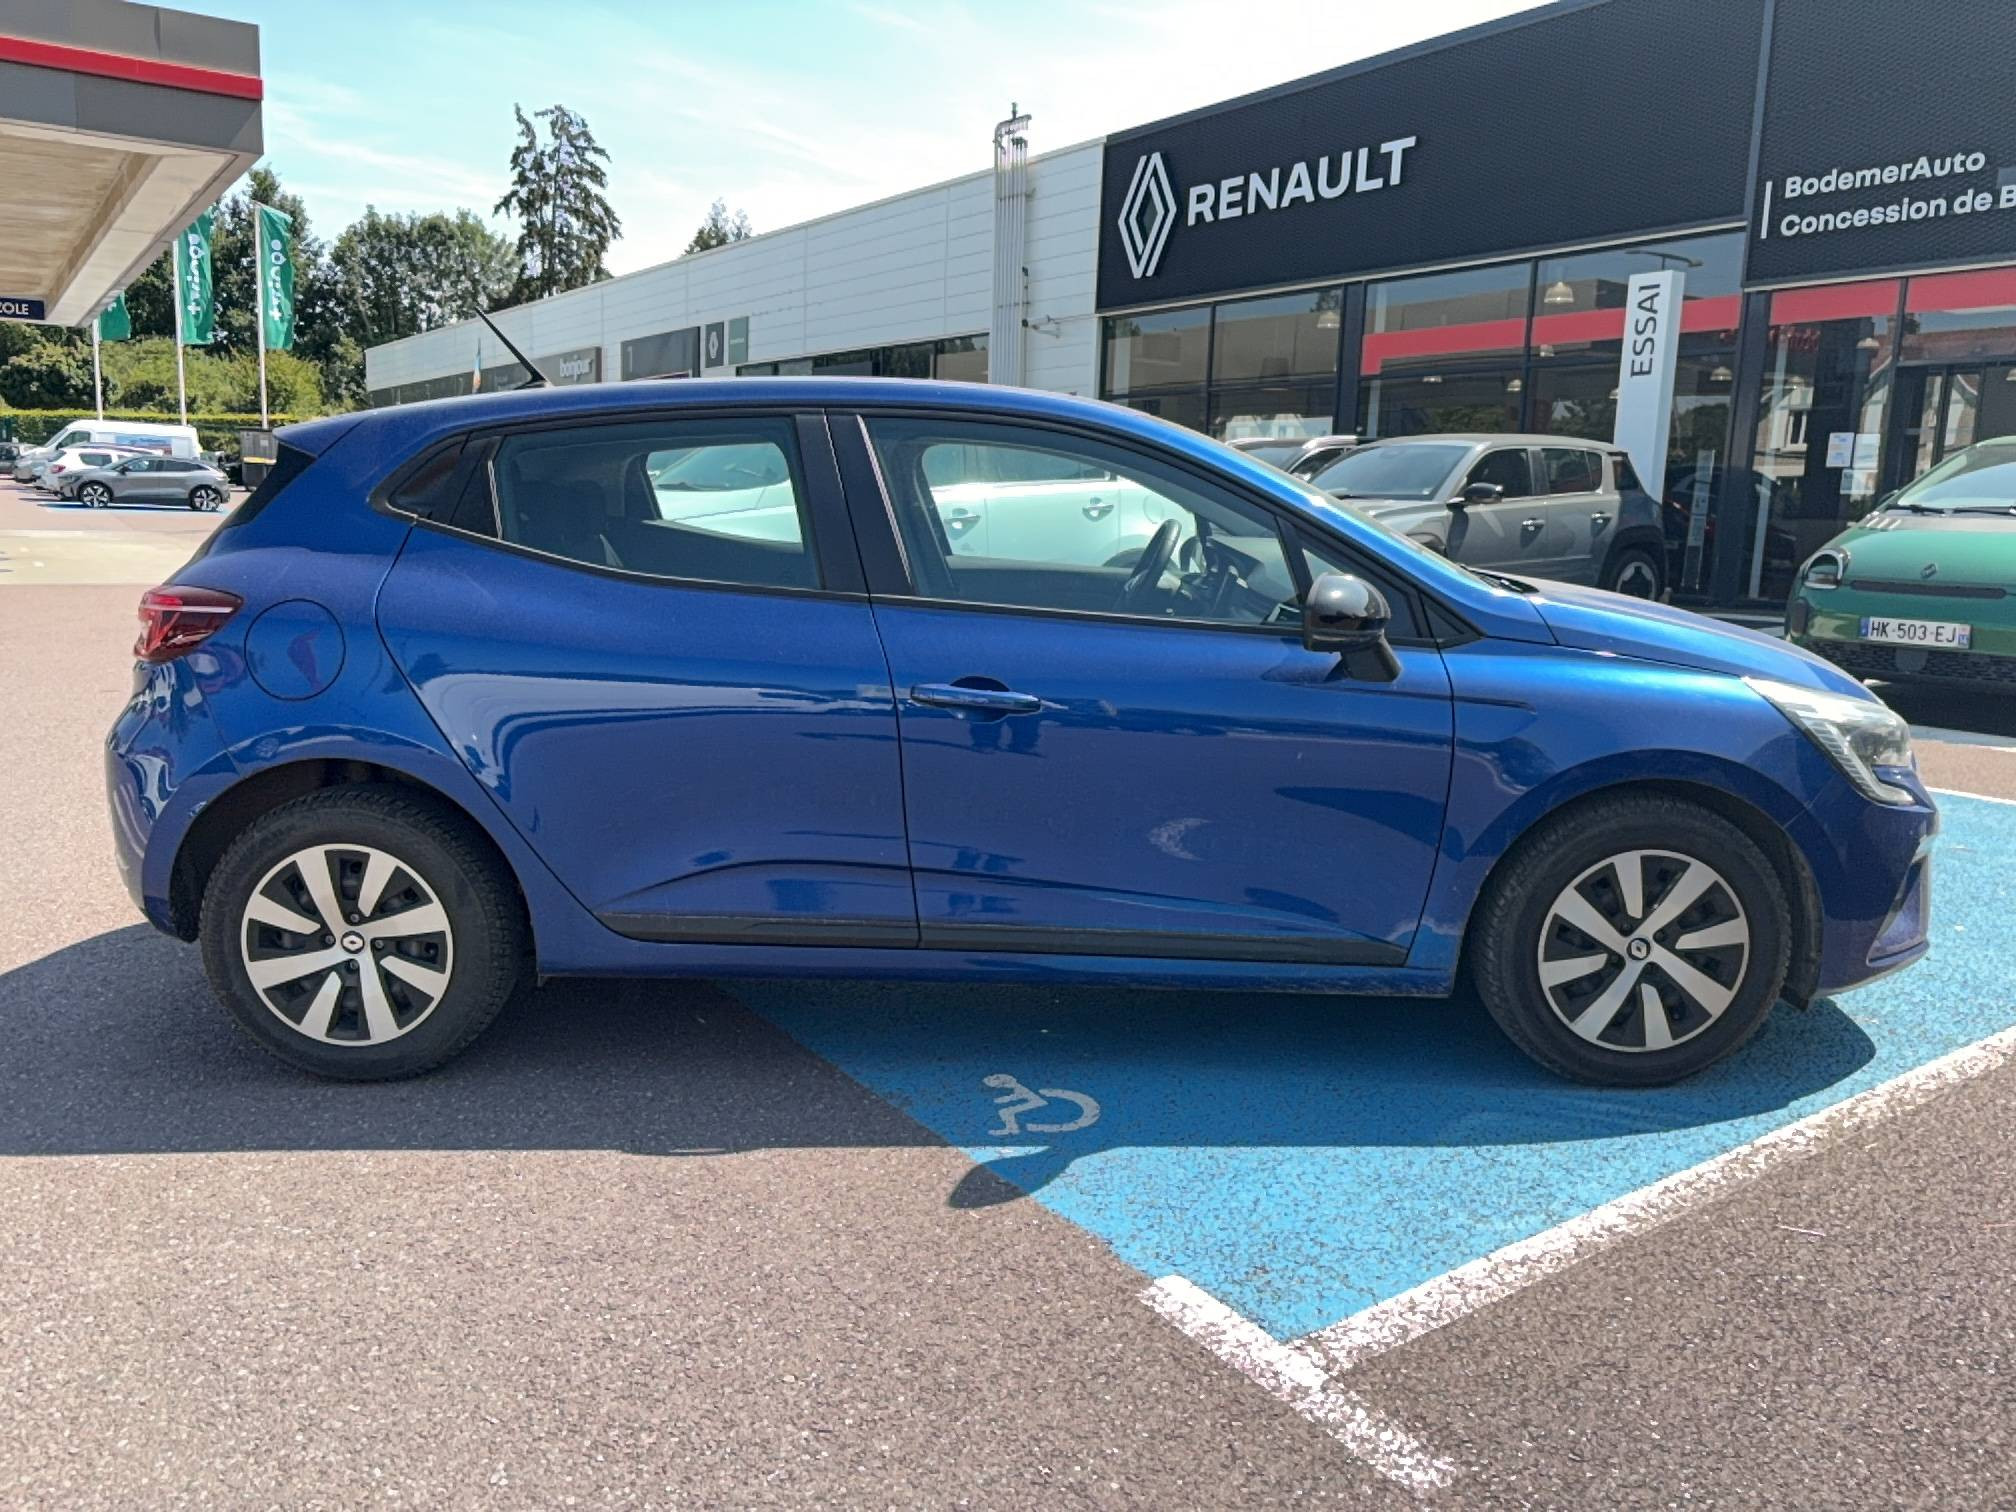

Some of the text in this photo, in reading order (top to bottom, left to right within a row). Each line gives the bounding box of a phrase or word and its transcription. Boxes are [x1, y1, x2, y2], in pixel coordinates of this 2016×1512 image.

[1187, 136, 1417, 227] RENAULT
[1784, 151, 1986, 199] BodemerAuto
[1779, 197, 1948, 237] Concession
[1952, 187, 1994, 215] de
[1630, 284, 1661, 378] ESSAI
